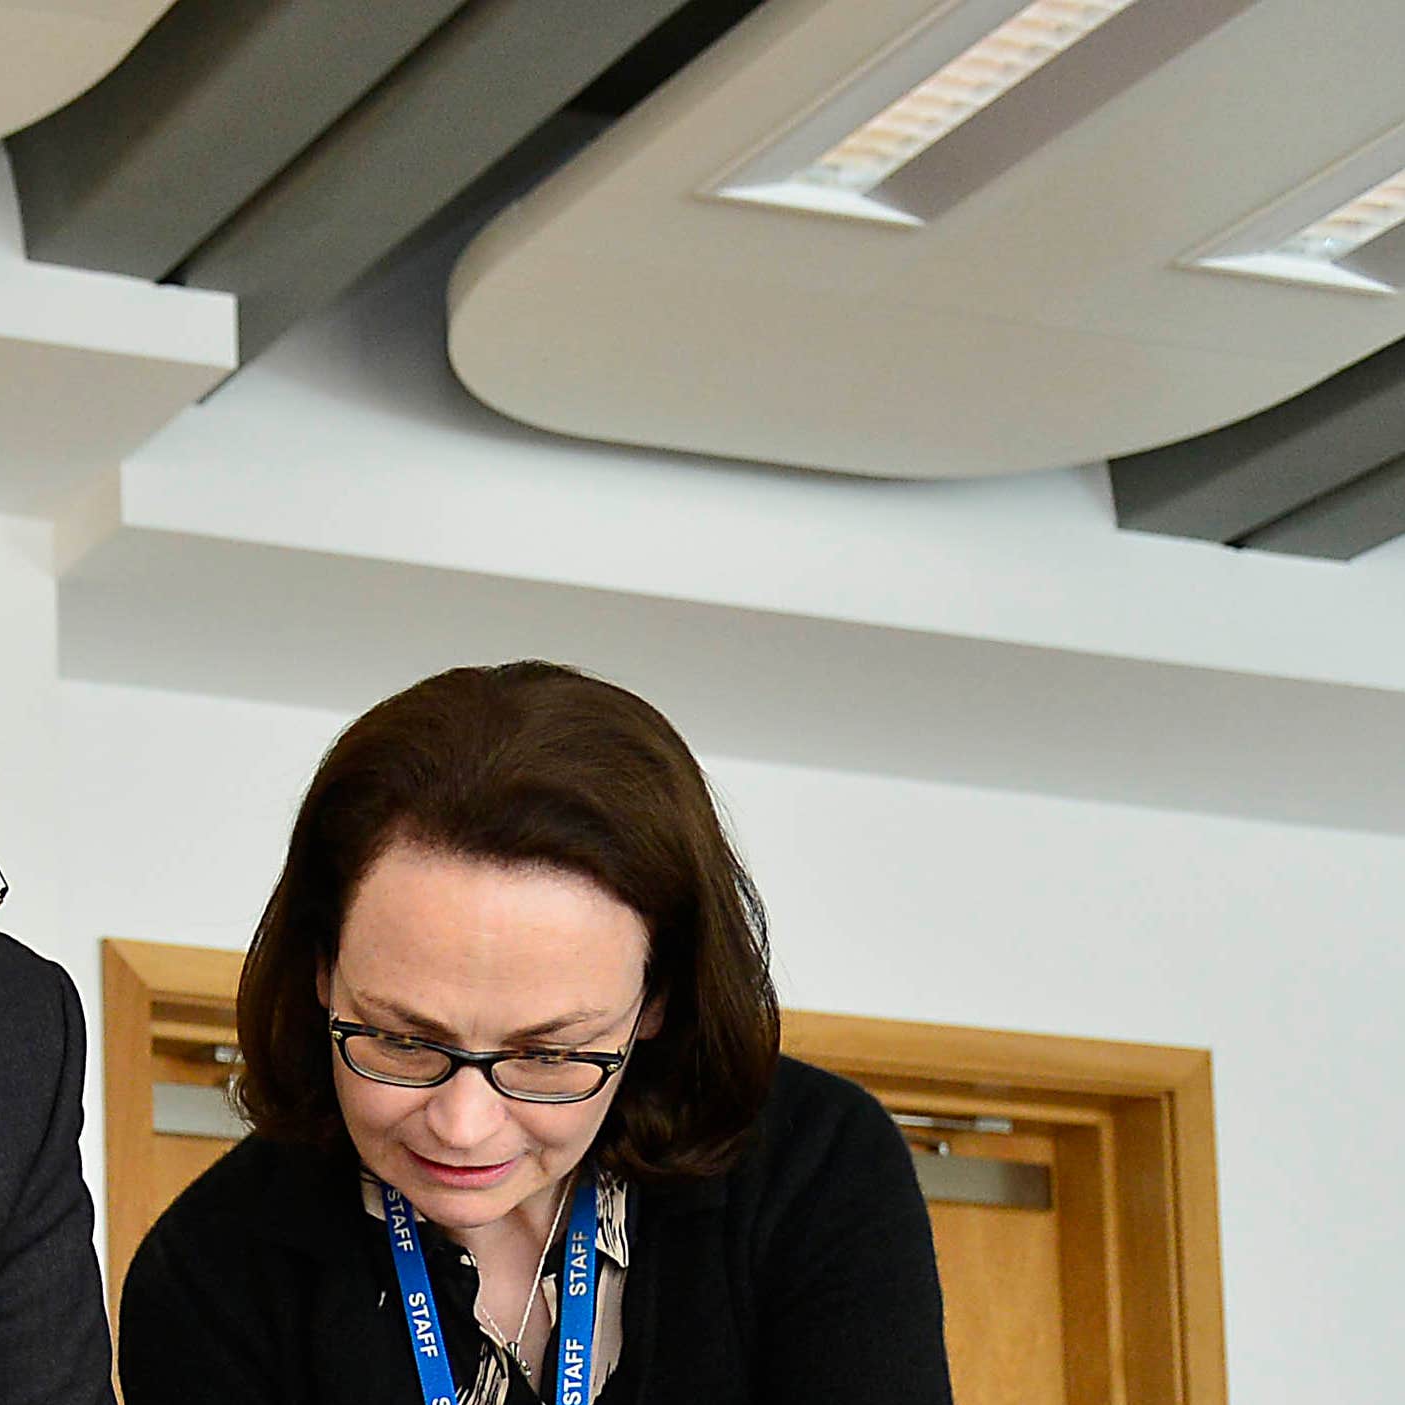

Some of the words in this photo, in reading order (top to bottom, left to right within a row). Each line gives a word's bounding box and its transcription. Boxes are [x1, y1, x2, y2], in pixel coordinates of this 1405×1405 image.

[387, 1188, 413, 1252] STAFF
[408, 1292, 438, 1358] STAFF
[568, 1231, 588, 1297] STAFF
[563, 1338, 585, 1405] STAFF
